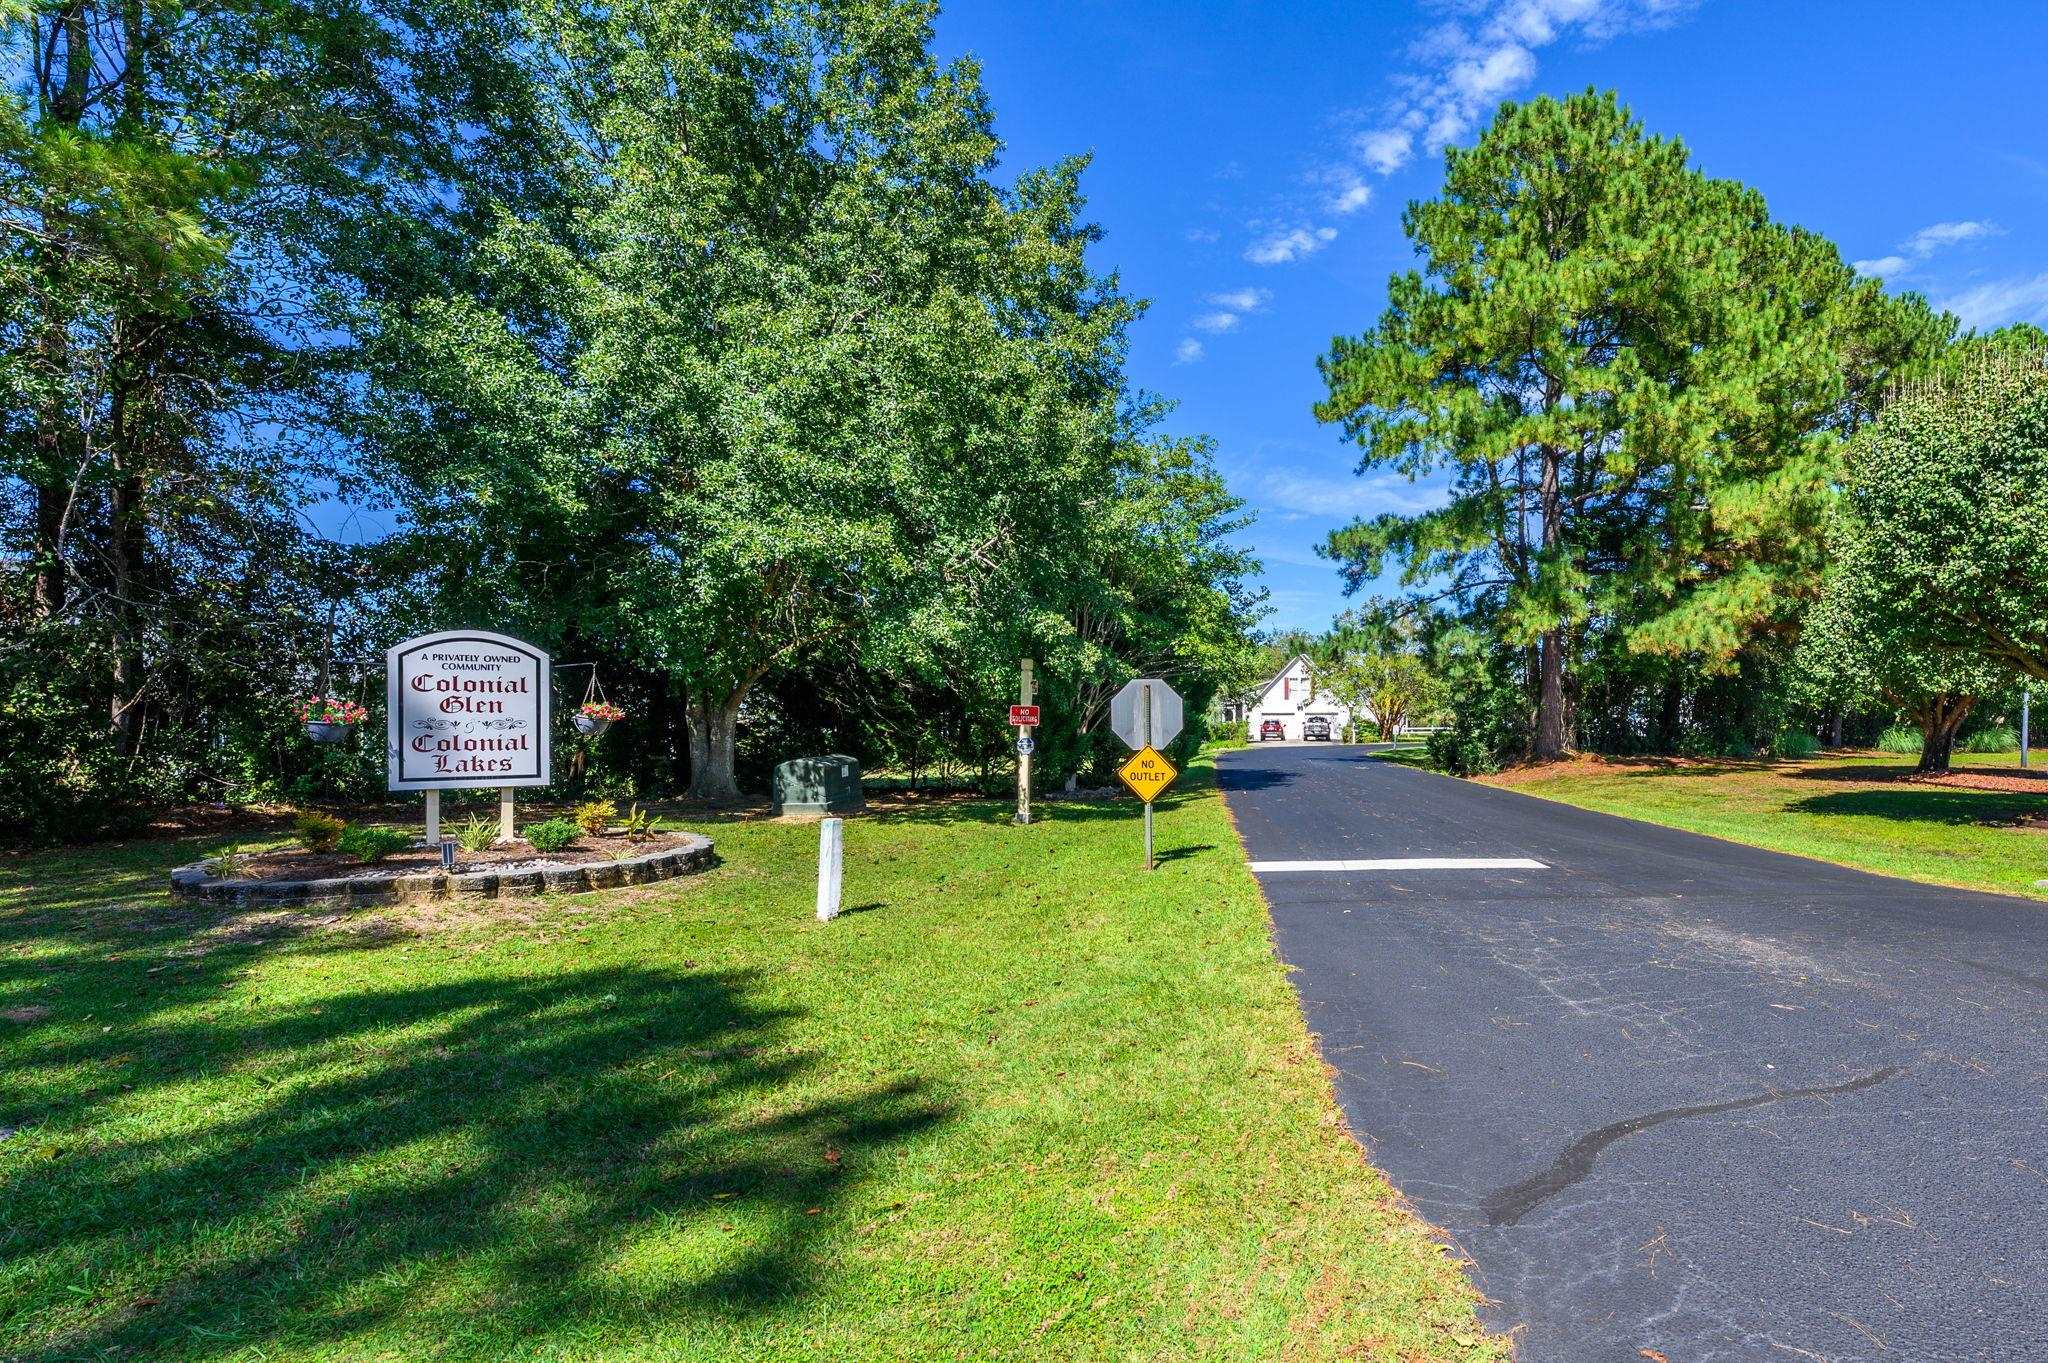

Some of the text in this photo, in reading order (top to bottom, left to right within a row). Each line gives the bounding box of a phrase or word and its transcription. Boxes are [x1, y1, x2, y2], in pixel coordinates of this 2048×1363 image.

[432, 654, 480, 662] PRIVATELY
[483, 655, 521, 663] OWNED
[441, 663, 502, 671] COMMUNITY
[411, 673, 529, 694] Colonial
[439, 695, 503, 713] Glen
[411, 733, 529, 752] Colonial
[431, 754, 513, 774] Lakes
[1141, 760, 1155, 769] NO
[1130, 772, 1166, 781] OUTLET
